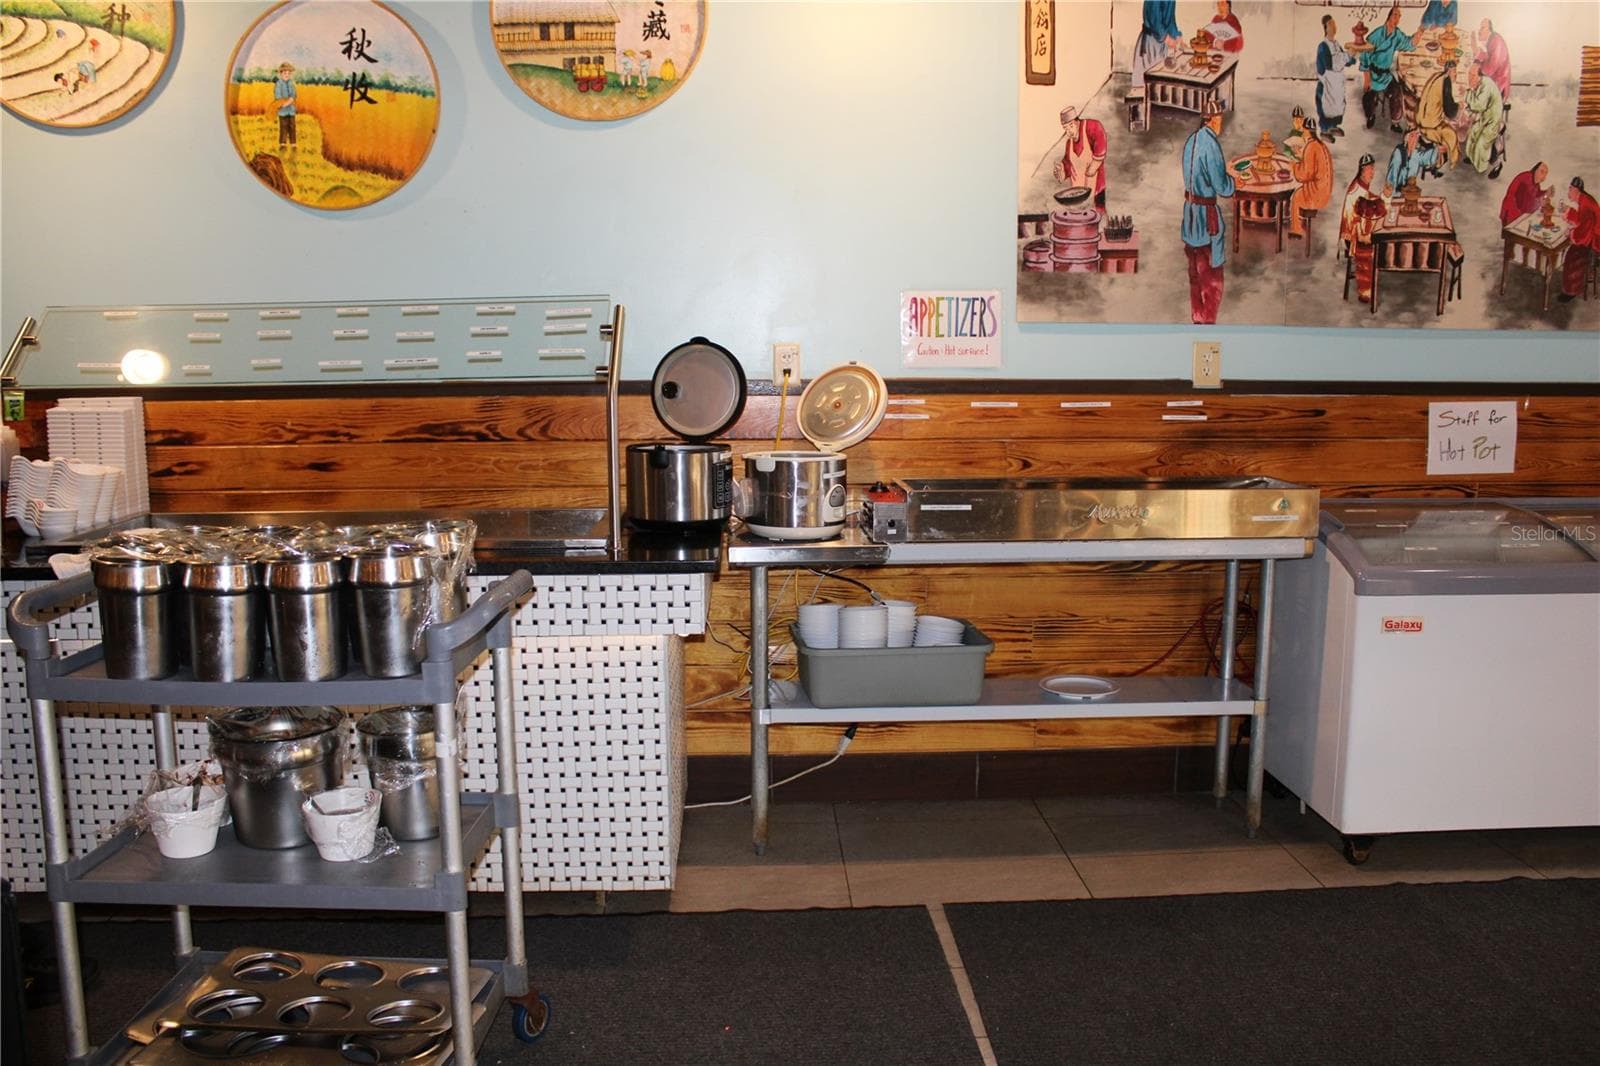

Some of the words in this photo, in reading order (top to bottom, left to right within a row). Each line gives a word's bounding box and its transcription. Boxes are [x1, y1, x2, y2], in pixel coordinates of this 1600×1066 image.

[339, 27, 379, 109] 秋收
[909, 296, 997, 338] APPETIZERS
[1437, 409, 1480, 428] Stuff
[1488, 409, 1508, 426] for
[1440, 437, 1466, 461] Hot
[1472, 436, 1502, 460] Pot
[1384, 620, 1423, 632] Galaxy
